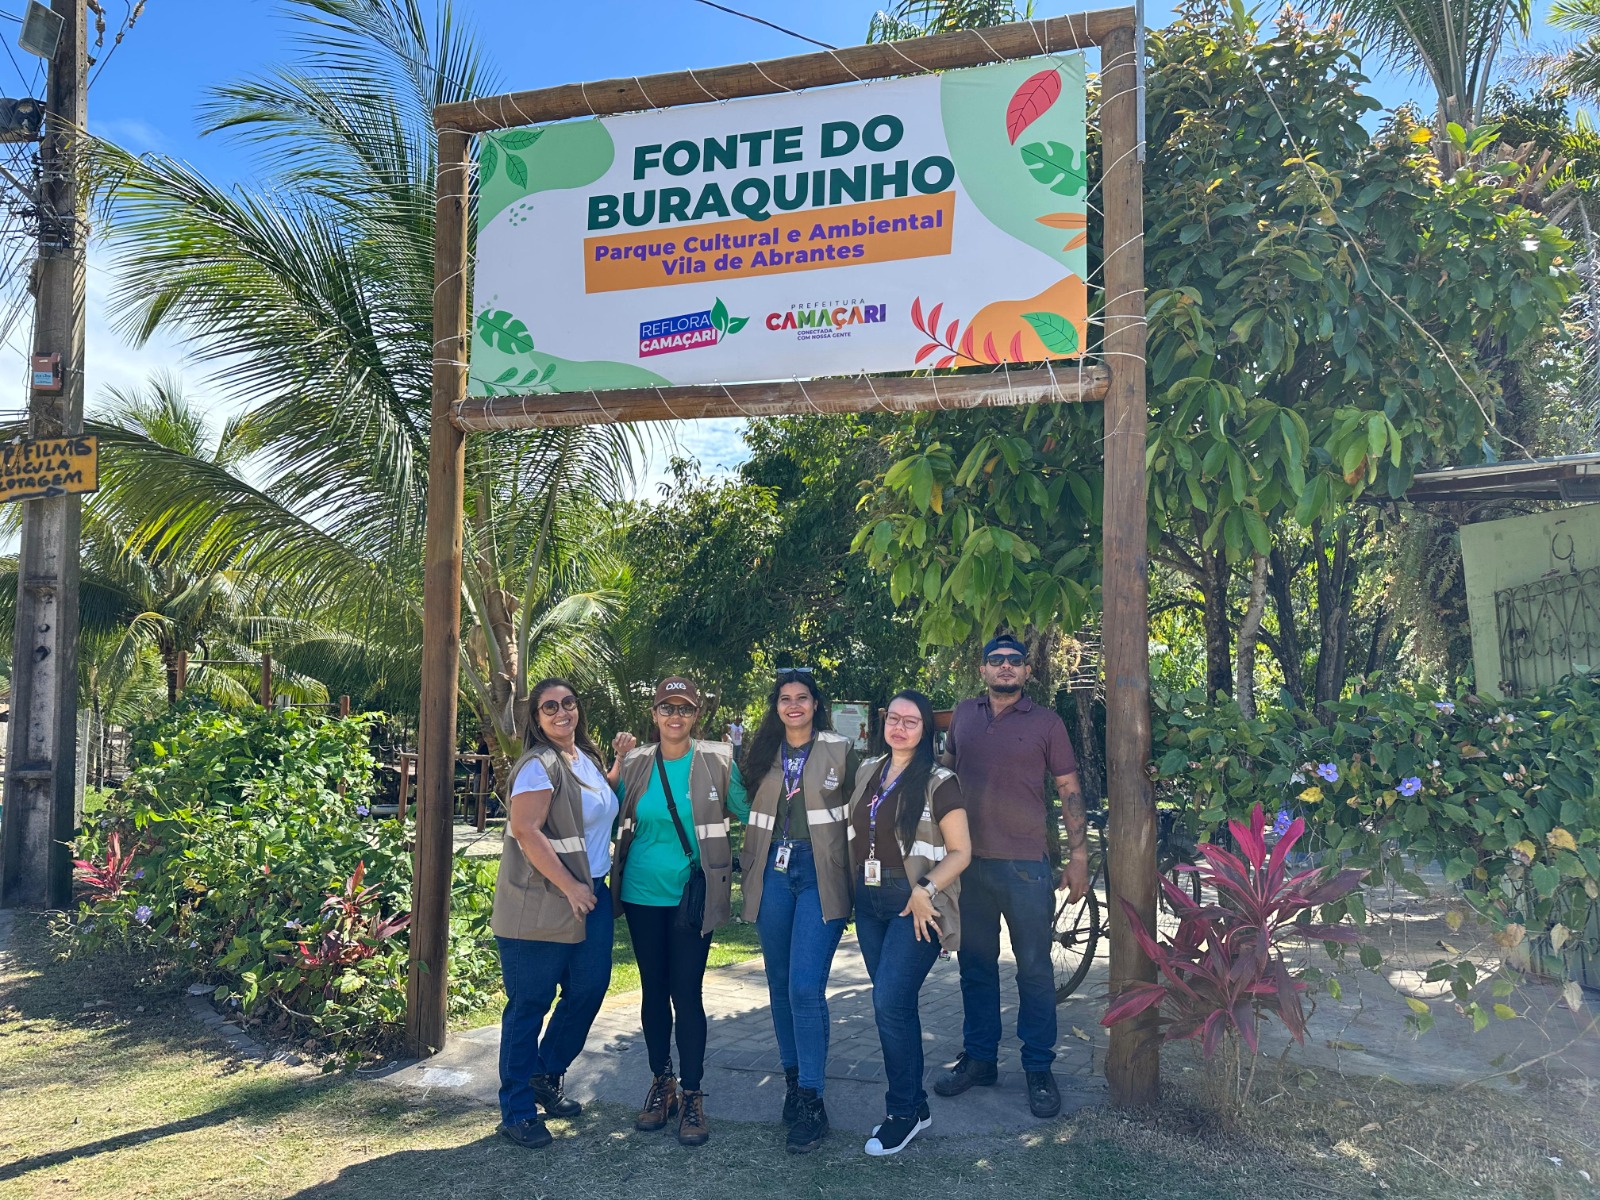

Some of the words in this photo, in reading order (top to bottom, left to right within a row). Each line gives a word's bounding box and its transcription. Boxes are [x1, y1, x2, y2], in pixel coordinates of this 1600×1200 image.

[633, 126, 803, 180] FONTE
[820, 114, 904, 159] DO
[587, 155, 955, 230] BURAQUINHO
[595, 239, 677, 262] Parque
[683, 228, 779, 253] Cultural
[787, 230, 801, 243] e
[808, 210, 943, 241] Ambiental
[661, 256, 706, 276] Vila
[714, 251, 742, 270] de
[751, 243, 865, 268] Abrantes
[765, 303, 886, 331] CAMAÇARI
[791, 298, 865, 310] PREFEITURA
[642, 314, 710, 337] REFLORA
[797, 328, 833, 336] CONECTADA
[640, 329, 716, 352] CAMAÇARI
[23, 436, 92, 461] FILMS
